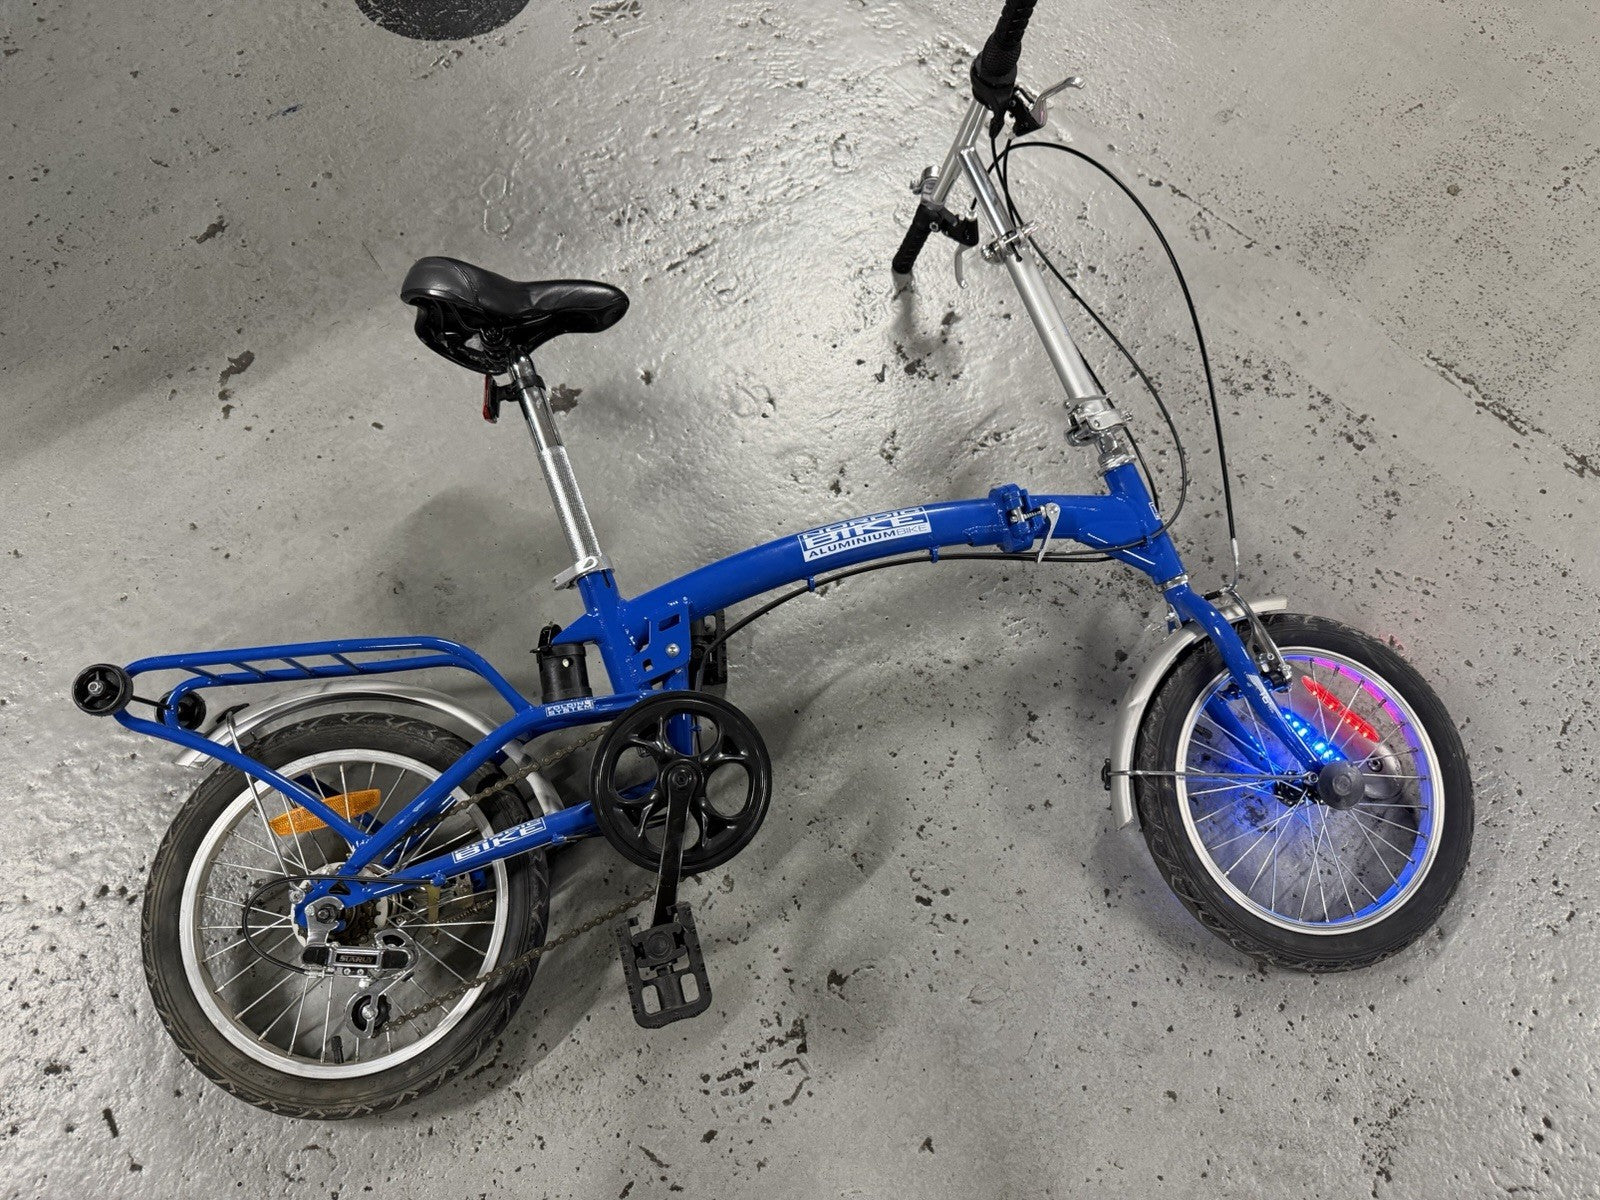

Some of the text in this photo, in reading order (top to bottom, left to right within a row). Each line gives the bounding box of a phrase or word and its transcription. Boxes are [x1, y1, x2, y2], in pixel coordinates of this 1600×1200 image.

[803, 511, 926, 550] BIKE
[808, 524, 929, 559] ALUMINIUMBIKE
[454, 820, 543, 861] BIKE
